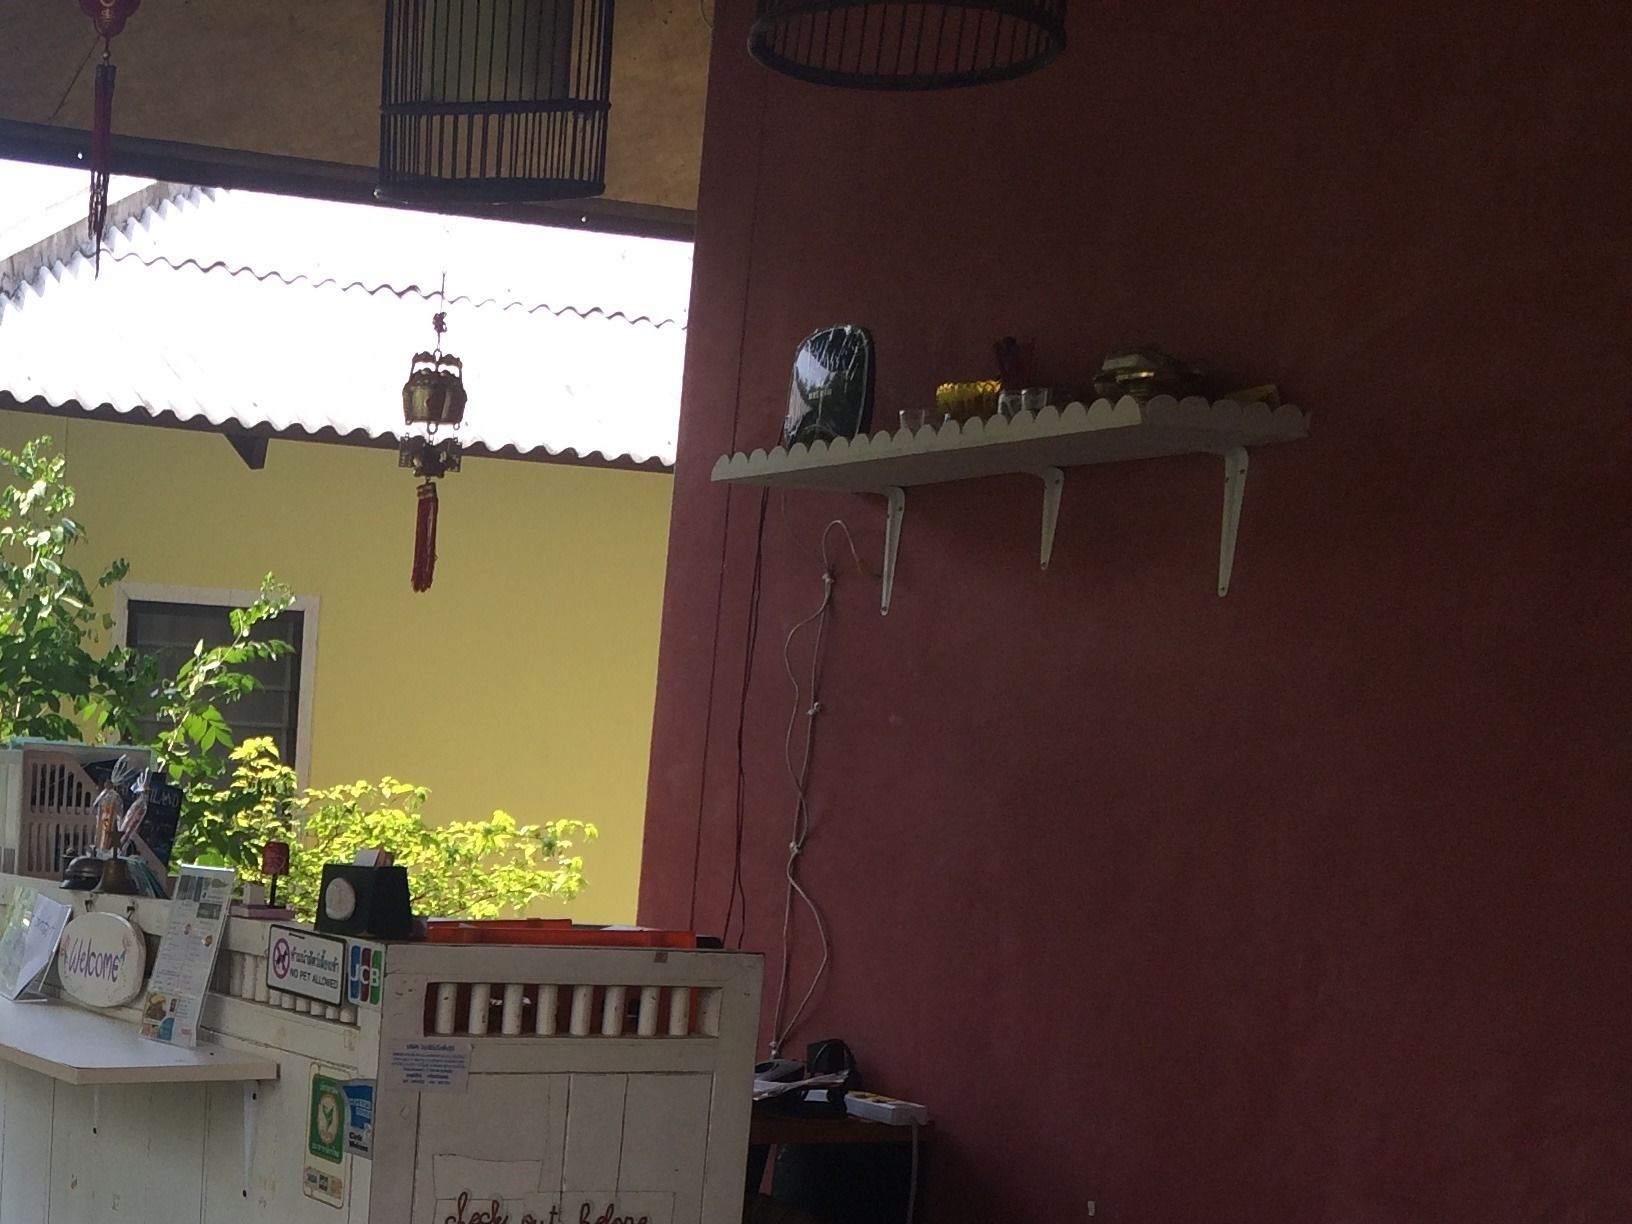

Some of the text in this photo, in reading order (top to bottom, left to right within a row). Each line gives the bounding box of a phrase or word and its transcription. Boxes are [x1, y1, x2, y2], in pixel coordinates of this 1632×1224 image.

[289, 968, 299, 979] NO
[300, 970, 311, 982] PET
[350, 963, 380, 987] JCB
